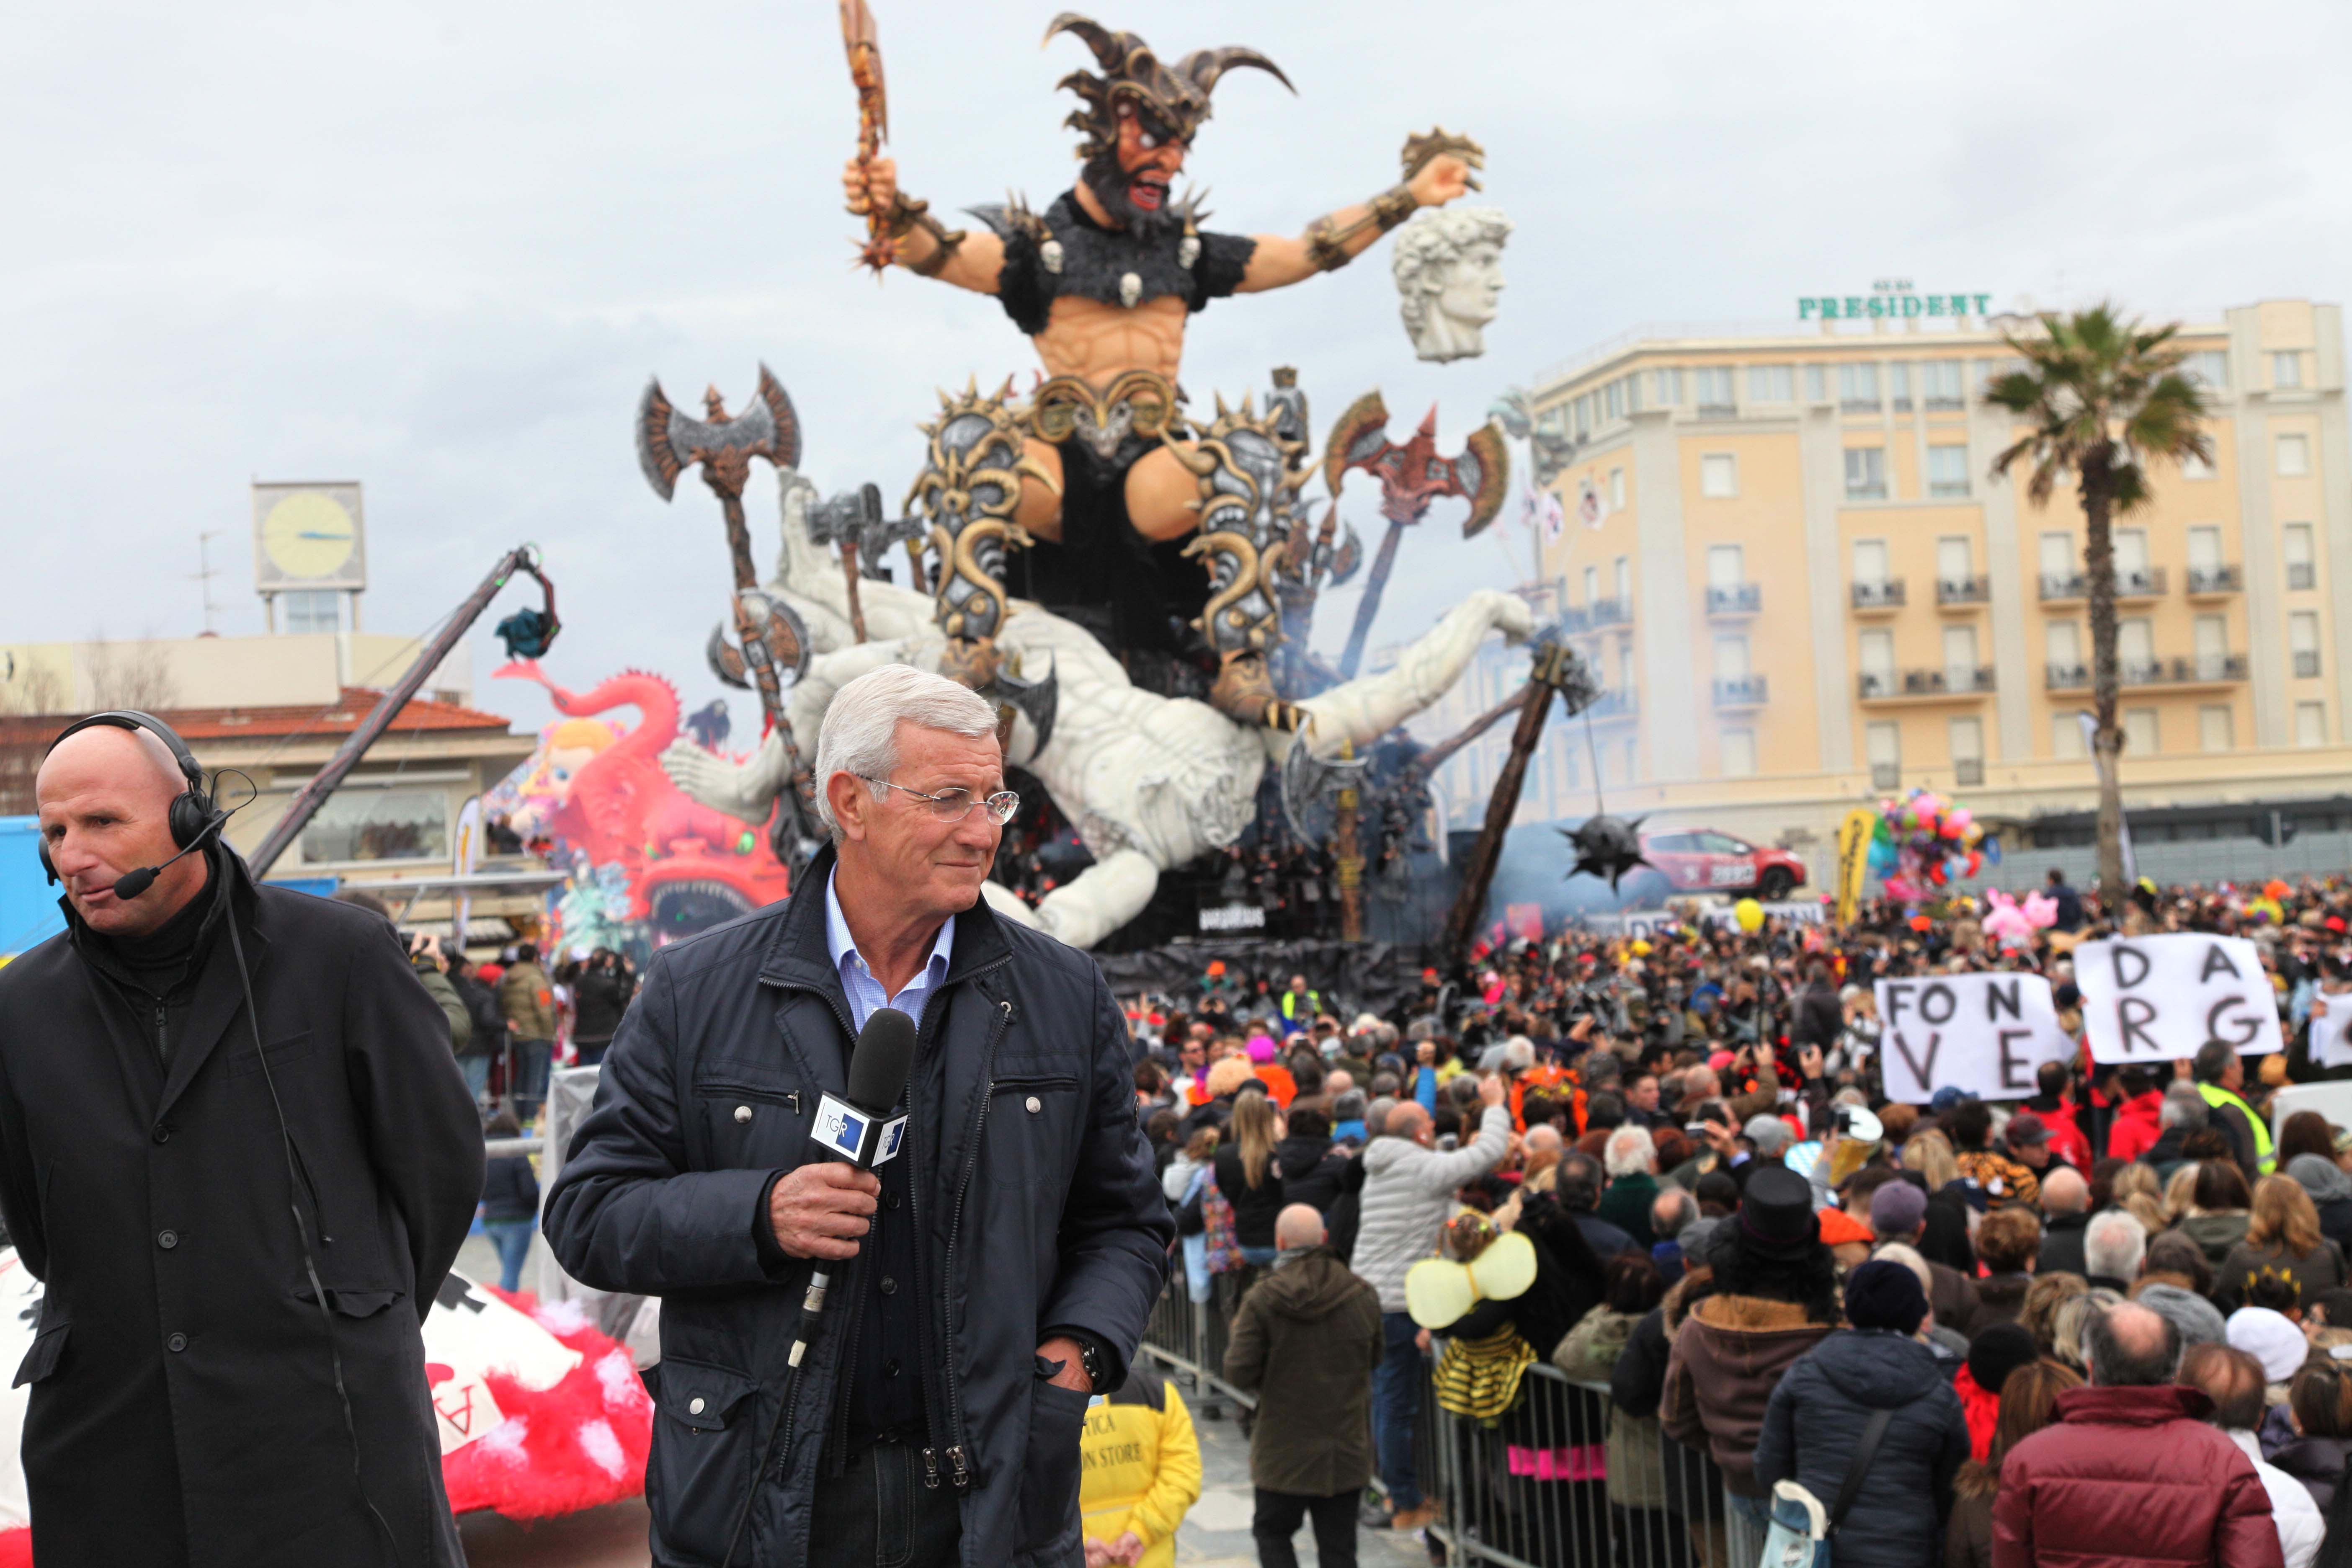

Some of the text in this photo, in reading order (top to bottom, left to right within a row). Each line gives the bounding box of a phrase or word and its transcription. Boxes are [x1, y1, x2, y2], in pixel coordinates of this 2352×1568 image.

[1798, 294, 1991, 319] PRESIDENT
[826, 1114, 847, 1137] TGR
[882, 1133, 895, 1149] TGR
[1100, 1443, 1142, 1467] STORE
